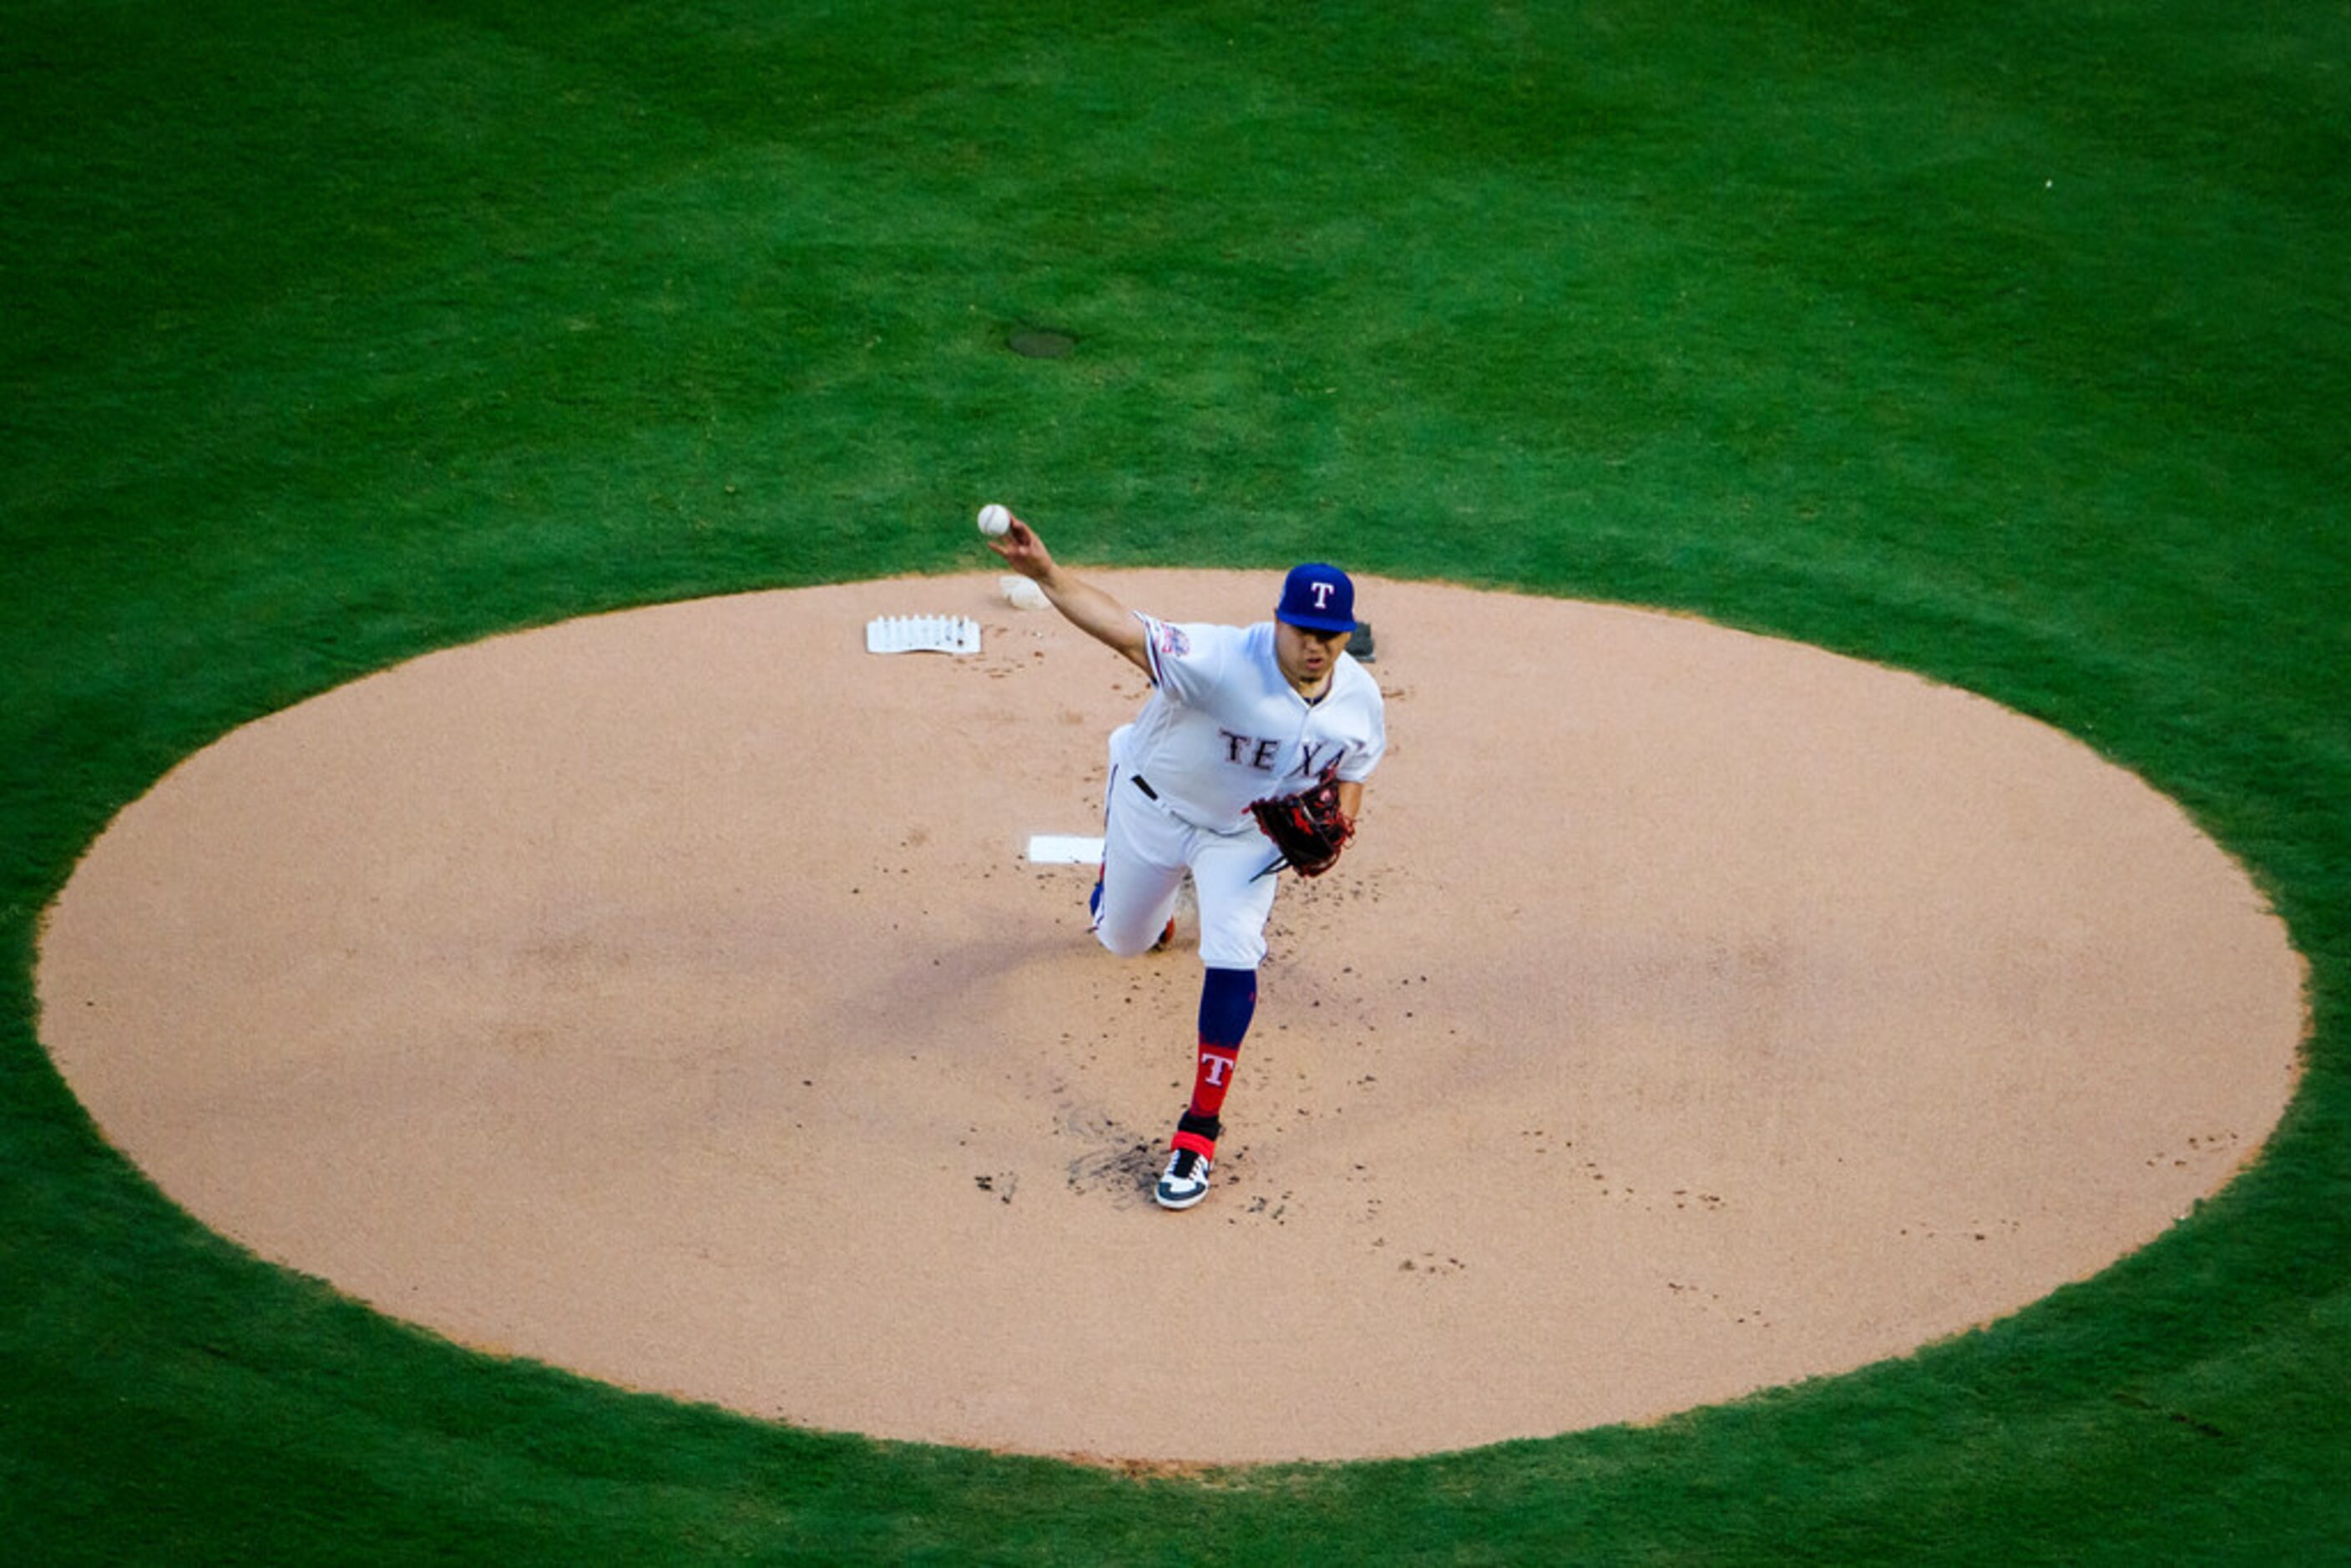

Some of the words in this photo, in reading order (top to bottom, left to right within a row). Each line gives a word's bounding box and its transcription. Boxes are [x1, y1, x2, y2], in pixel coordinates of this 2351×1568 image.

[1311, 582, 1334, 609] T
[1219, 726, 1367, 779] TEXA
[1201, 1053, 1234, 1086] T
